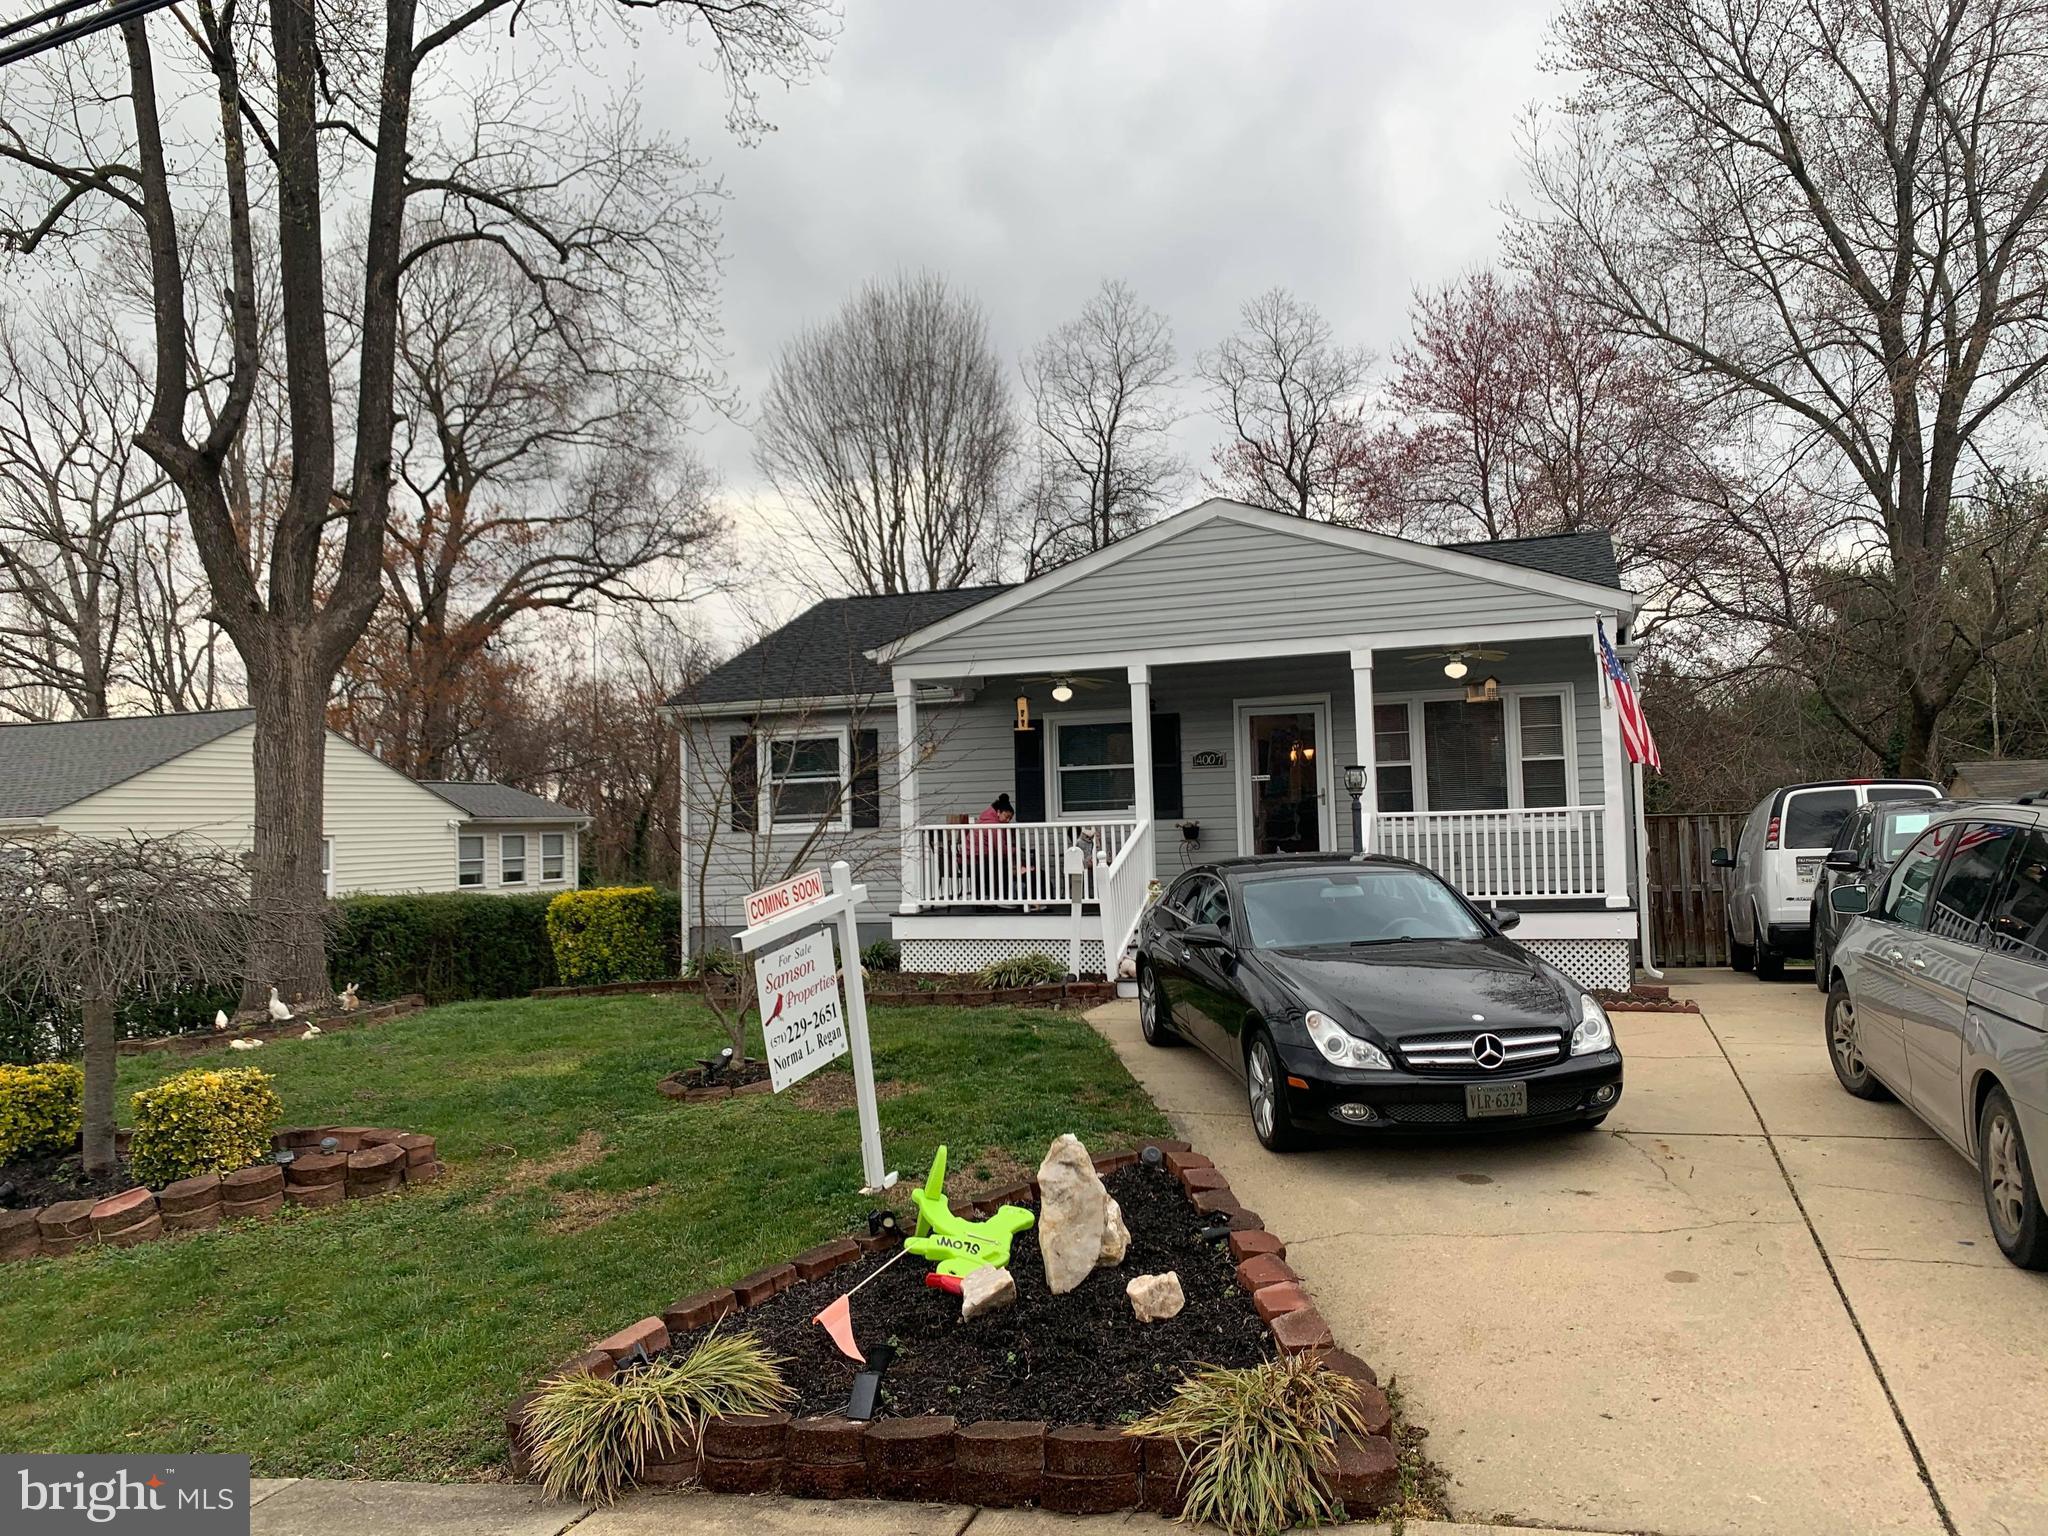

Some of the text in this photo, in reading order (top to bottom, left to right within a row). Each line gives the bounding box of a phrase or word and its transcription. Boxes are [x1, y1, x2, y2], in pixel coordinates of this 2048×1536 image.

[750, 877, 820, 920] COMING SOON
[778, 943, 812, 968] For Sale
[765, 959, 816, 994] Samson
[785, 974, 836, 1009] Properties
[773, 1026, 842, 1075] Norma L. Regan
